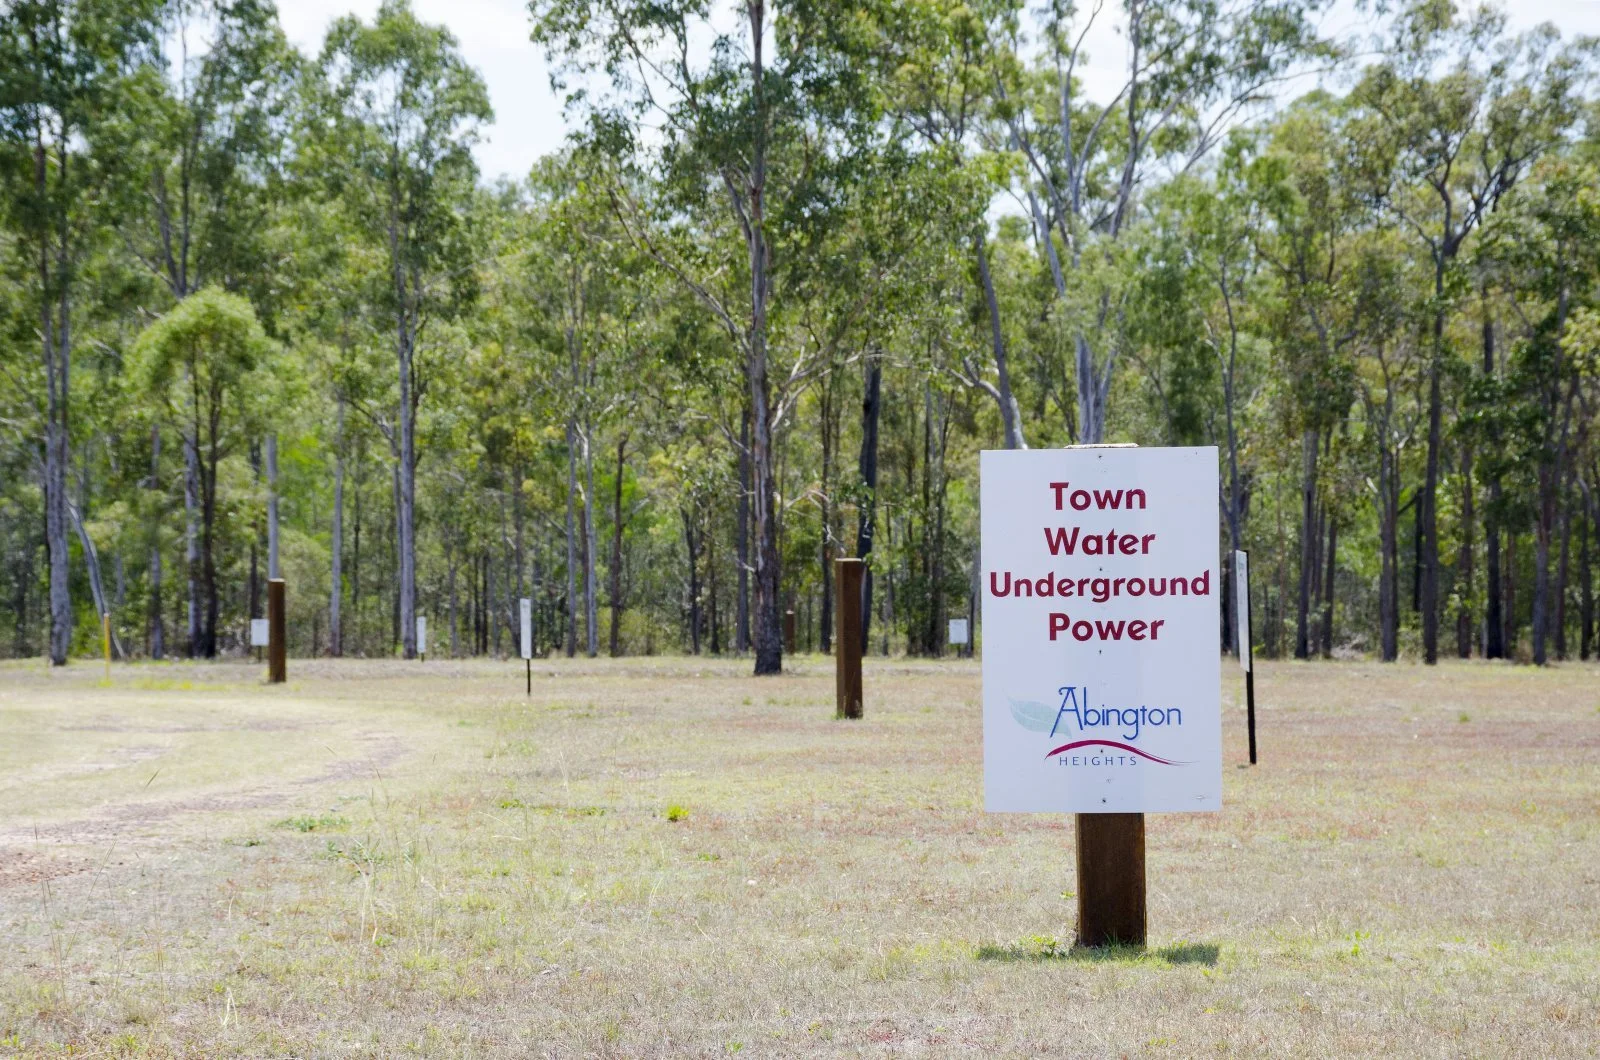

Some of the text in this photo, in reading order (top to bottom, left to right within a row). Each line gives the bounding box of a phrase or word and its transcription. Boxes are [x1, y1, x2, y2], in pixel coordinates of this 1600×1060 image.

[1049, 482, 1147, 511] Town
[1043, 527, 1156, 555] Water
[990, 569, 1210, 603] Underground
[1049, 612, 1165, 642] Power
[1050, 686, 1182, 740] Abington
[1059, 756, 1138, 767] HEIGHTS
